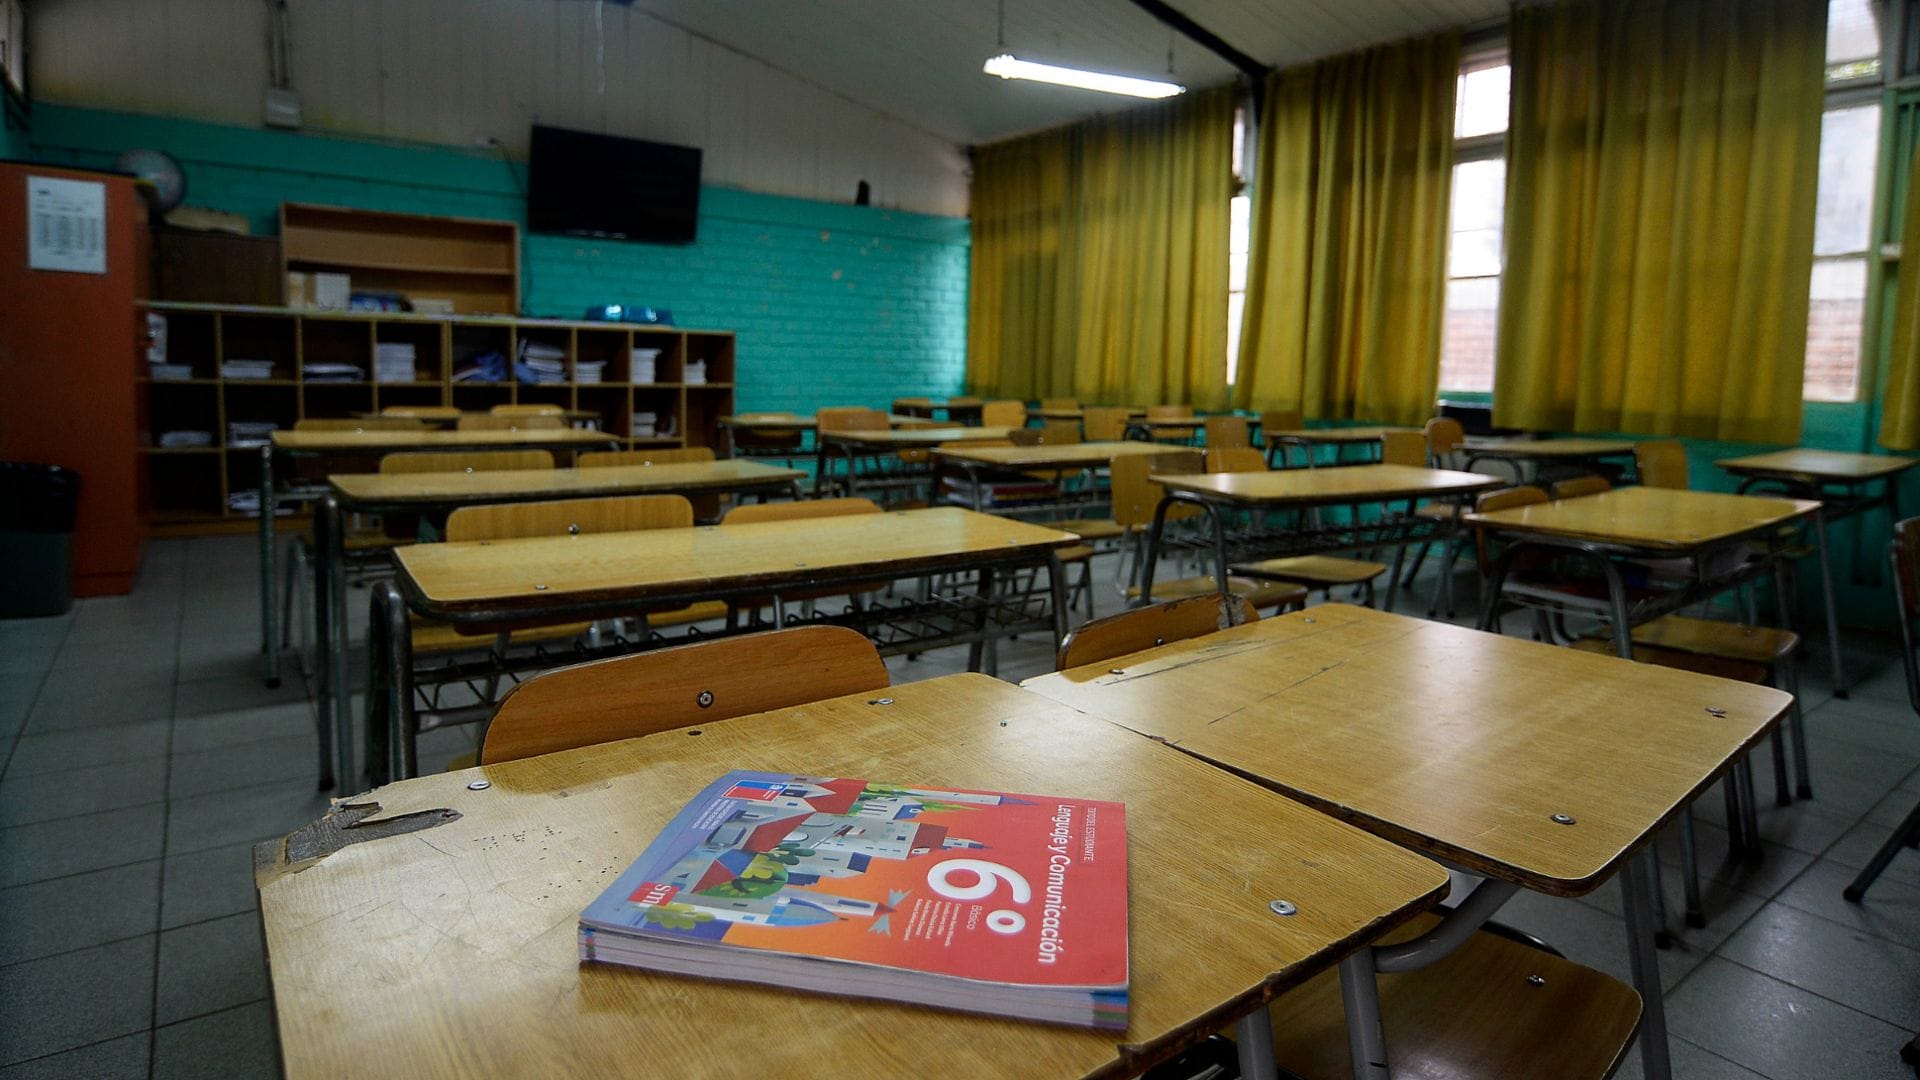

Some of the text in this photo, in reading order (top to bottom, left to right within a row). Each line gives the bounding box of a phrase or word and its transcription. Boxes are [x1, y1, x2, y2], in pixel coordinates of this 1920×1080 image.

[1038, 804, 1076, 964] Lenguaje y Comunicación
[1083, 828, 1096, 862] ESTUDIANTE
